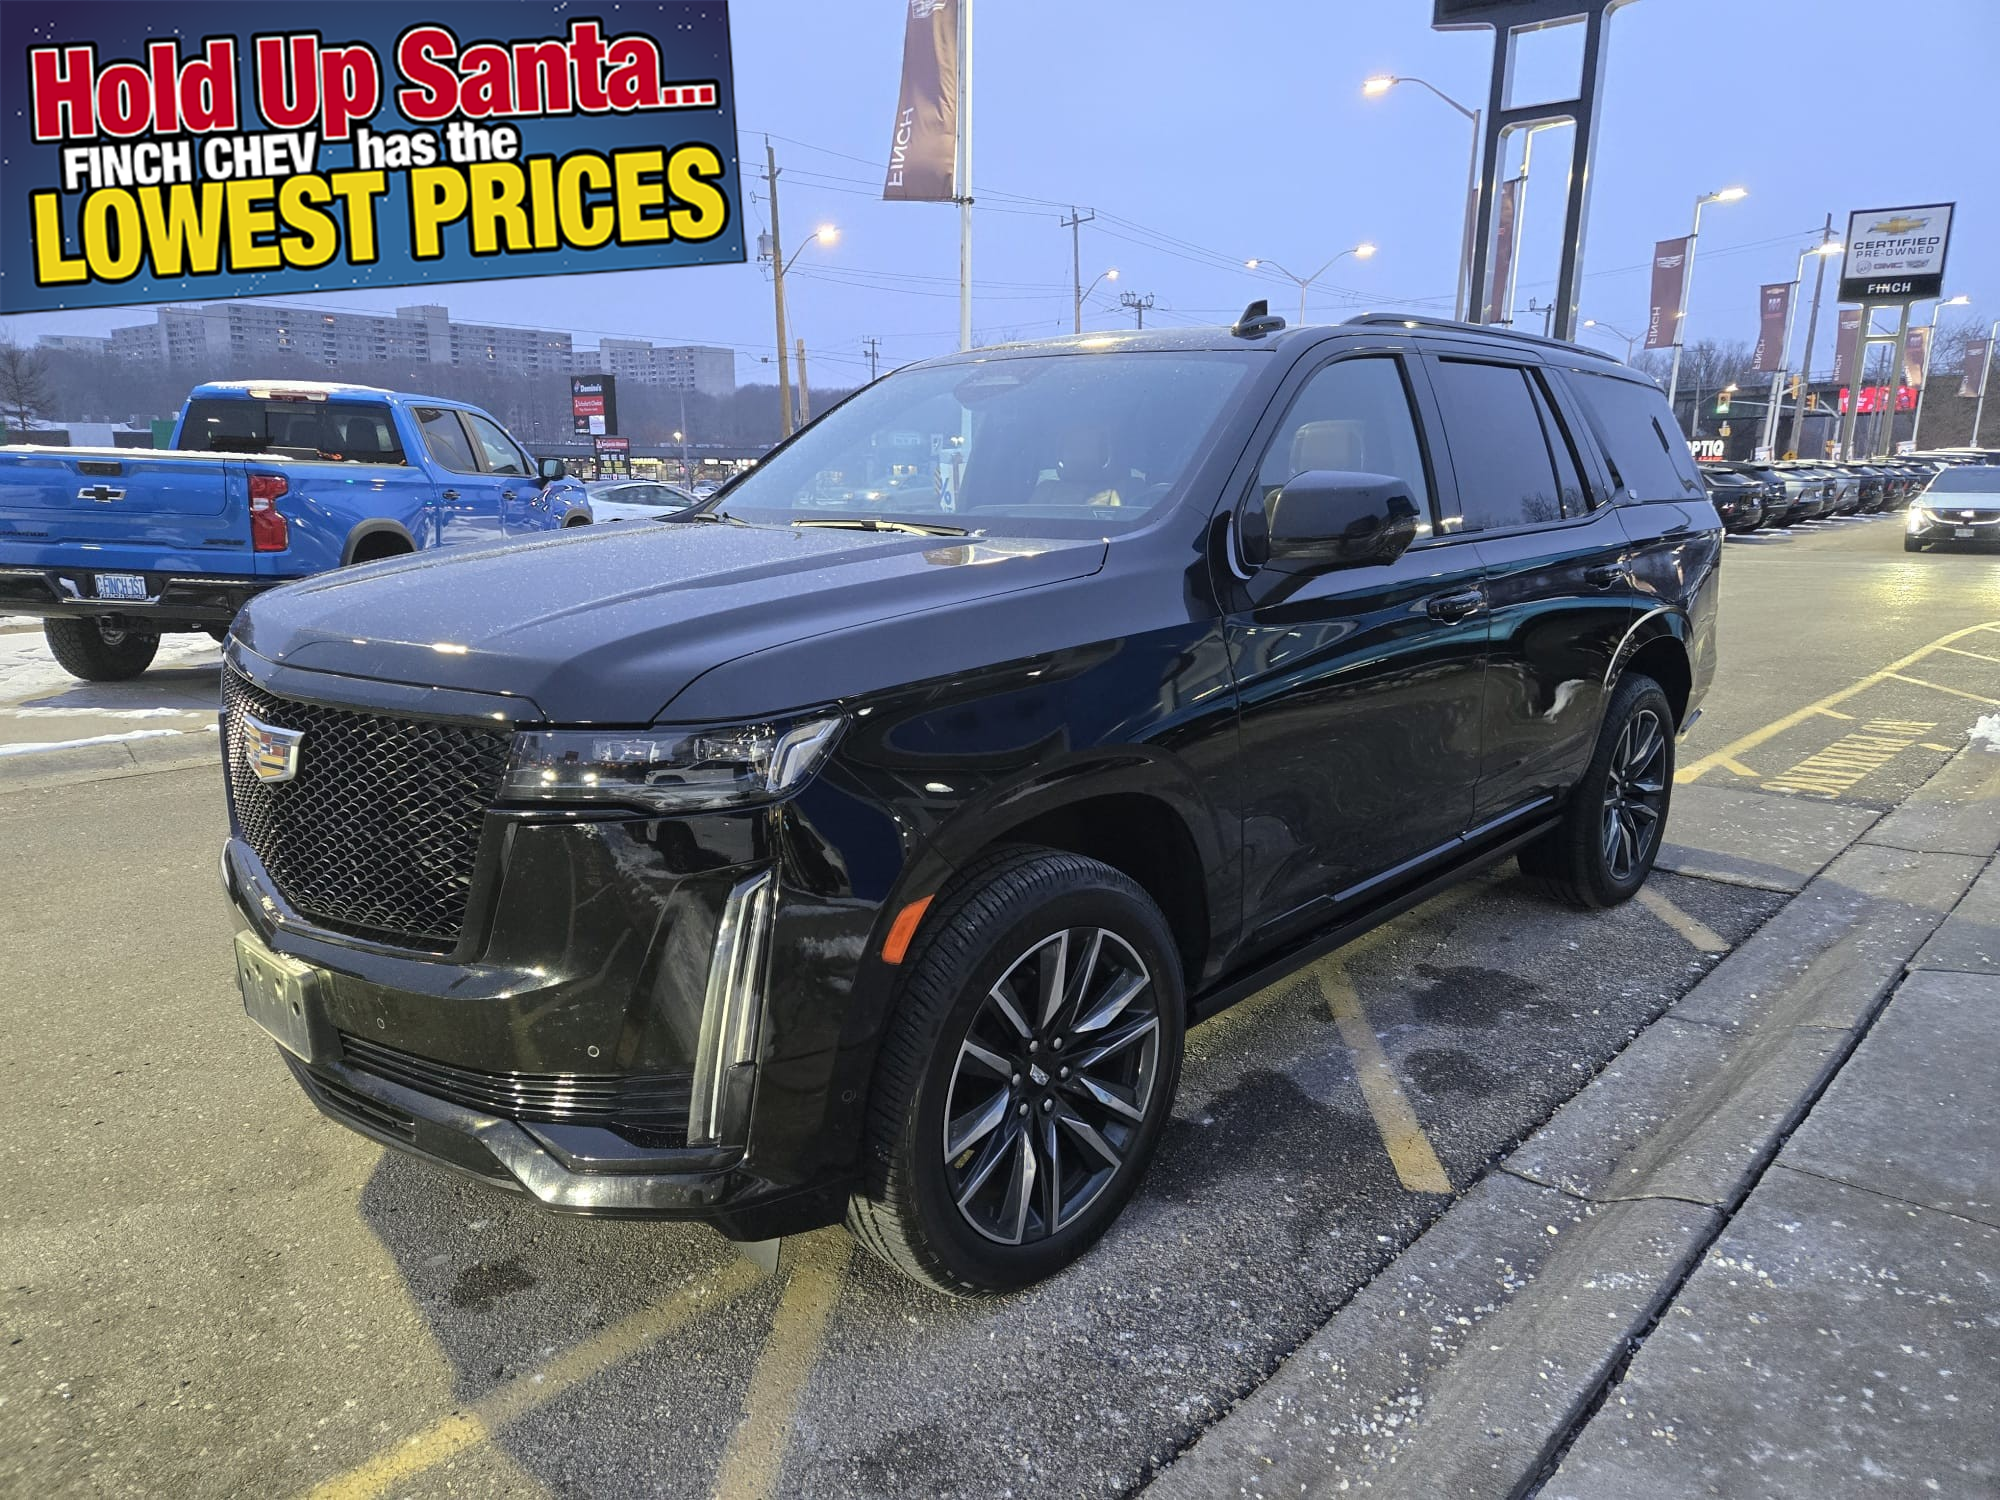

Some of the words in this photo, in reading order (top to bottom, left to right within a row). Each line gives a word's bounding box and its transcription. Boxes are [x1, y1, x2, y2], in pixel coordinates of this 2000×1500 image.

[1853, 236, 1940, 250] CERTIFIED
[1856, 246, 1935, 258] PRE-OWNED
[1873, 261, 1904, 270] GMC
[1867, 282, 1912, 294] FINCH
